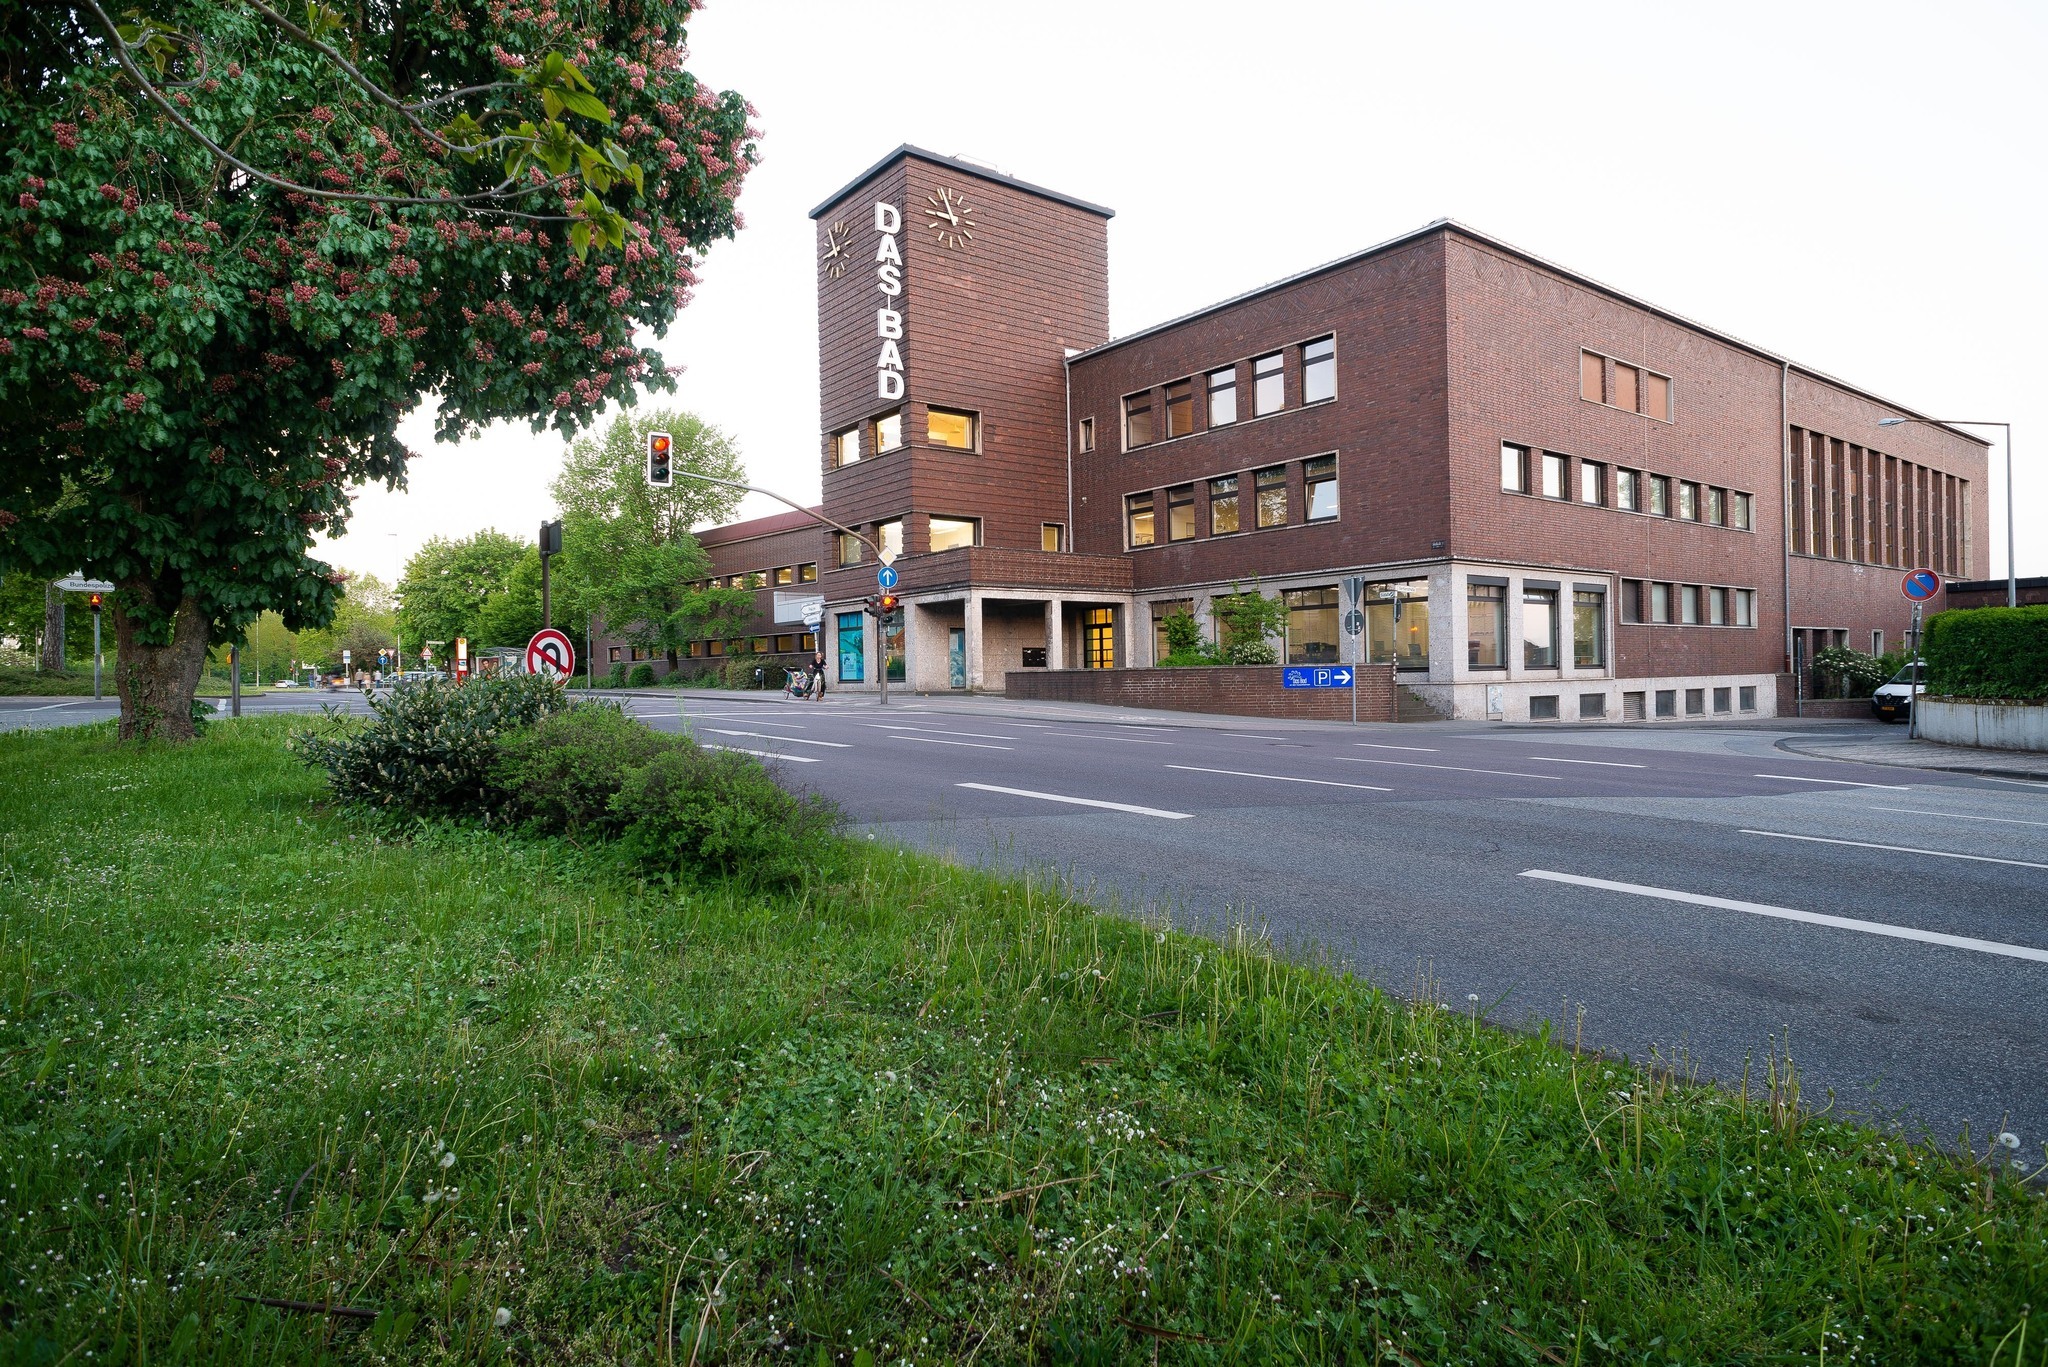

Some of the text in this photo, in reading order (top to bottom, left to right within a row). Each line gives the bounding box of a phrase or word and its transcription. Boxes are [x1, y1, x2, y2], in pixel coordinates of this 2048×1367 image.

[875, 201, 905, 400] DAS BAD
[69, 581, 114, 589] Bundespolize
[1318, 671, 1328, 684] P
